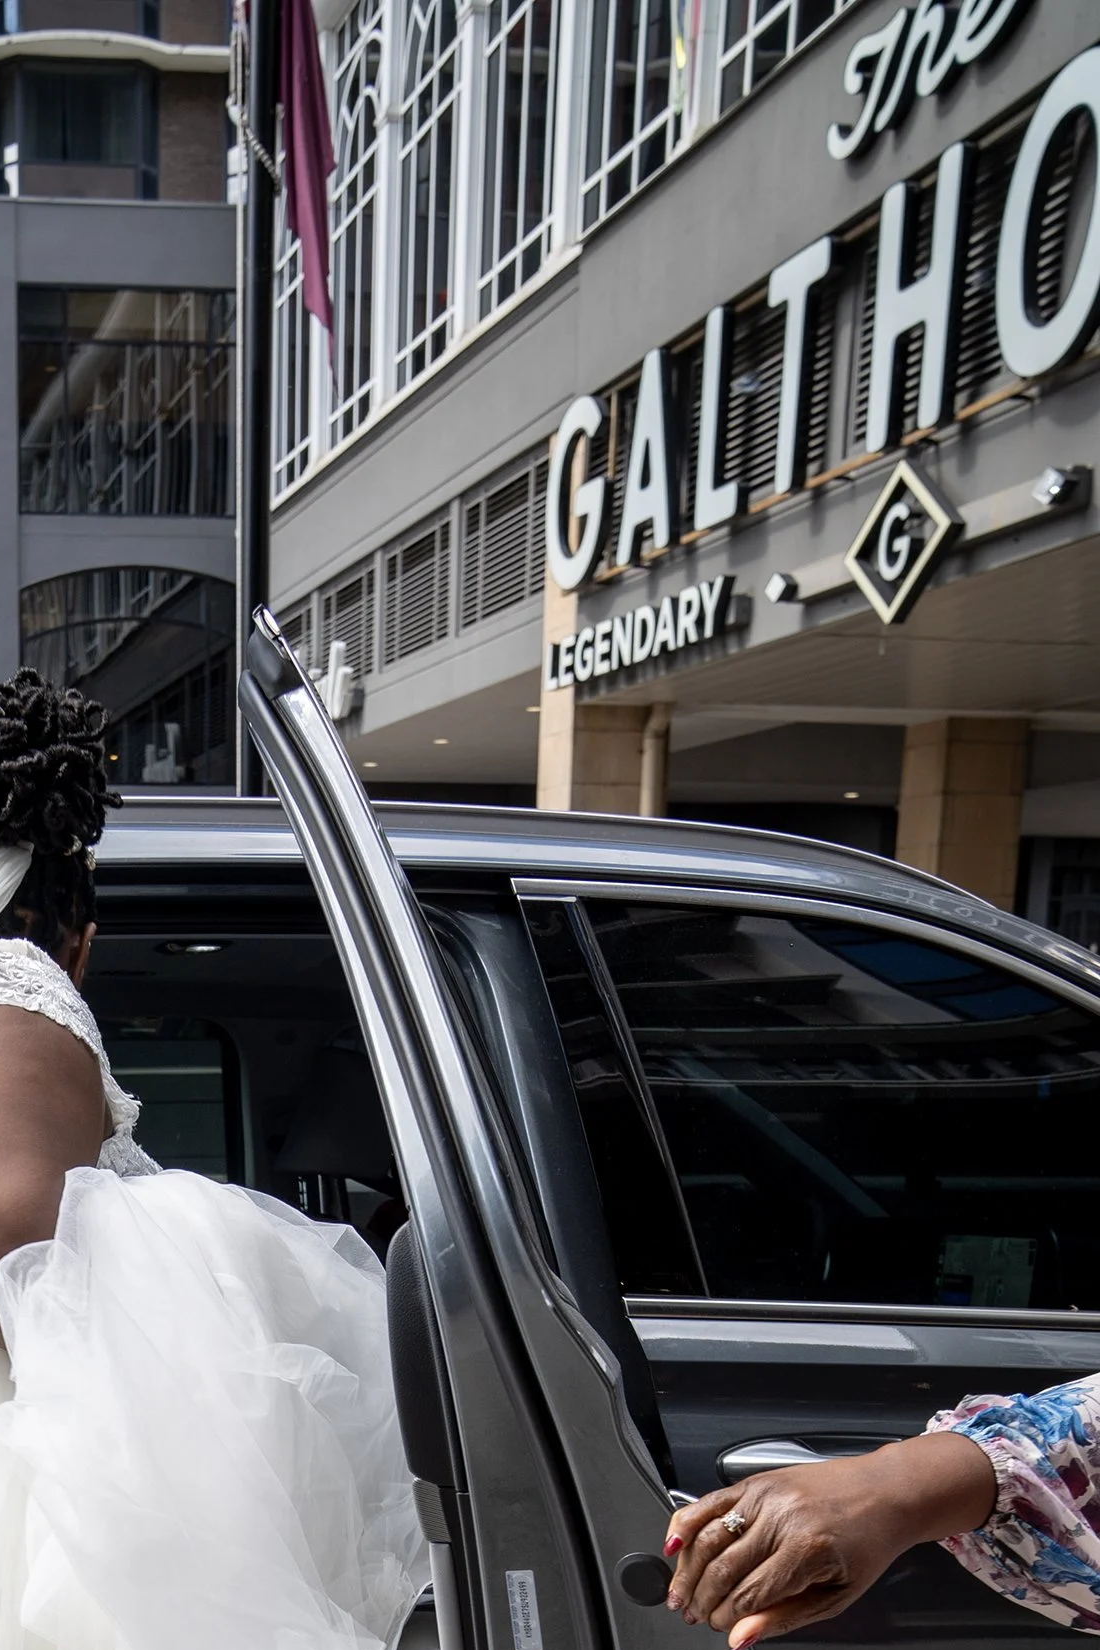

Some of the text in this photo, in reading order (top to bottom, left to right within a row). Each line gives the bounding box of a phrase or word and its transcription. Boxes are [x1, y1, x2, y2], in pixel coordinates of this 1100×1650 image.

[827, 0, 1016, 160] The
[878, 502, 911, 582] G
[544, 574, 725, 691] LEGENDARY
